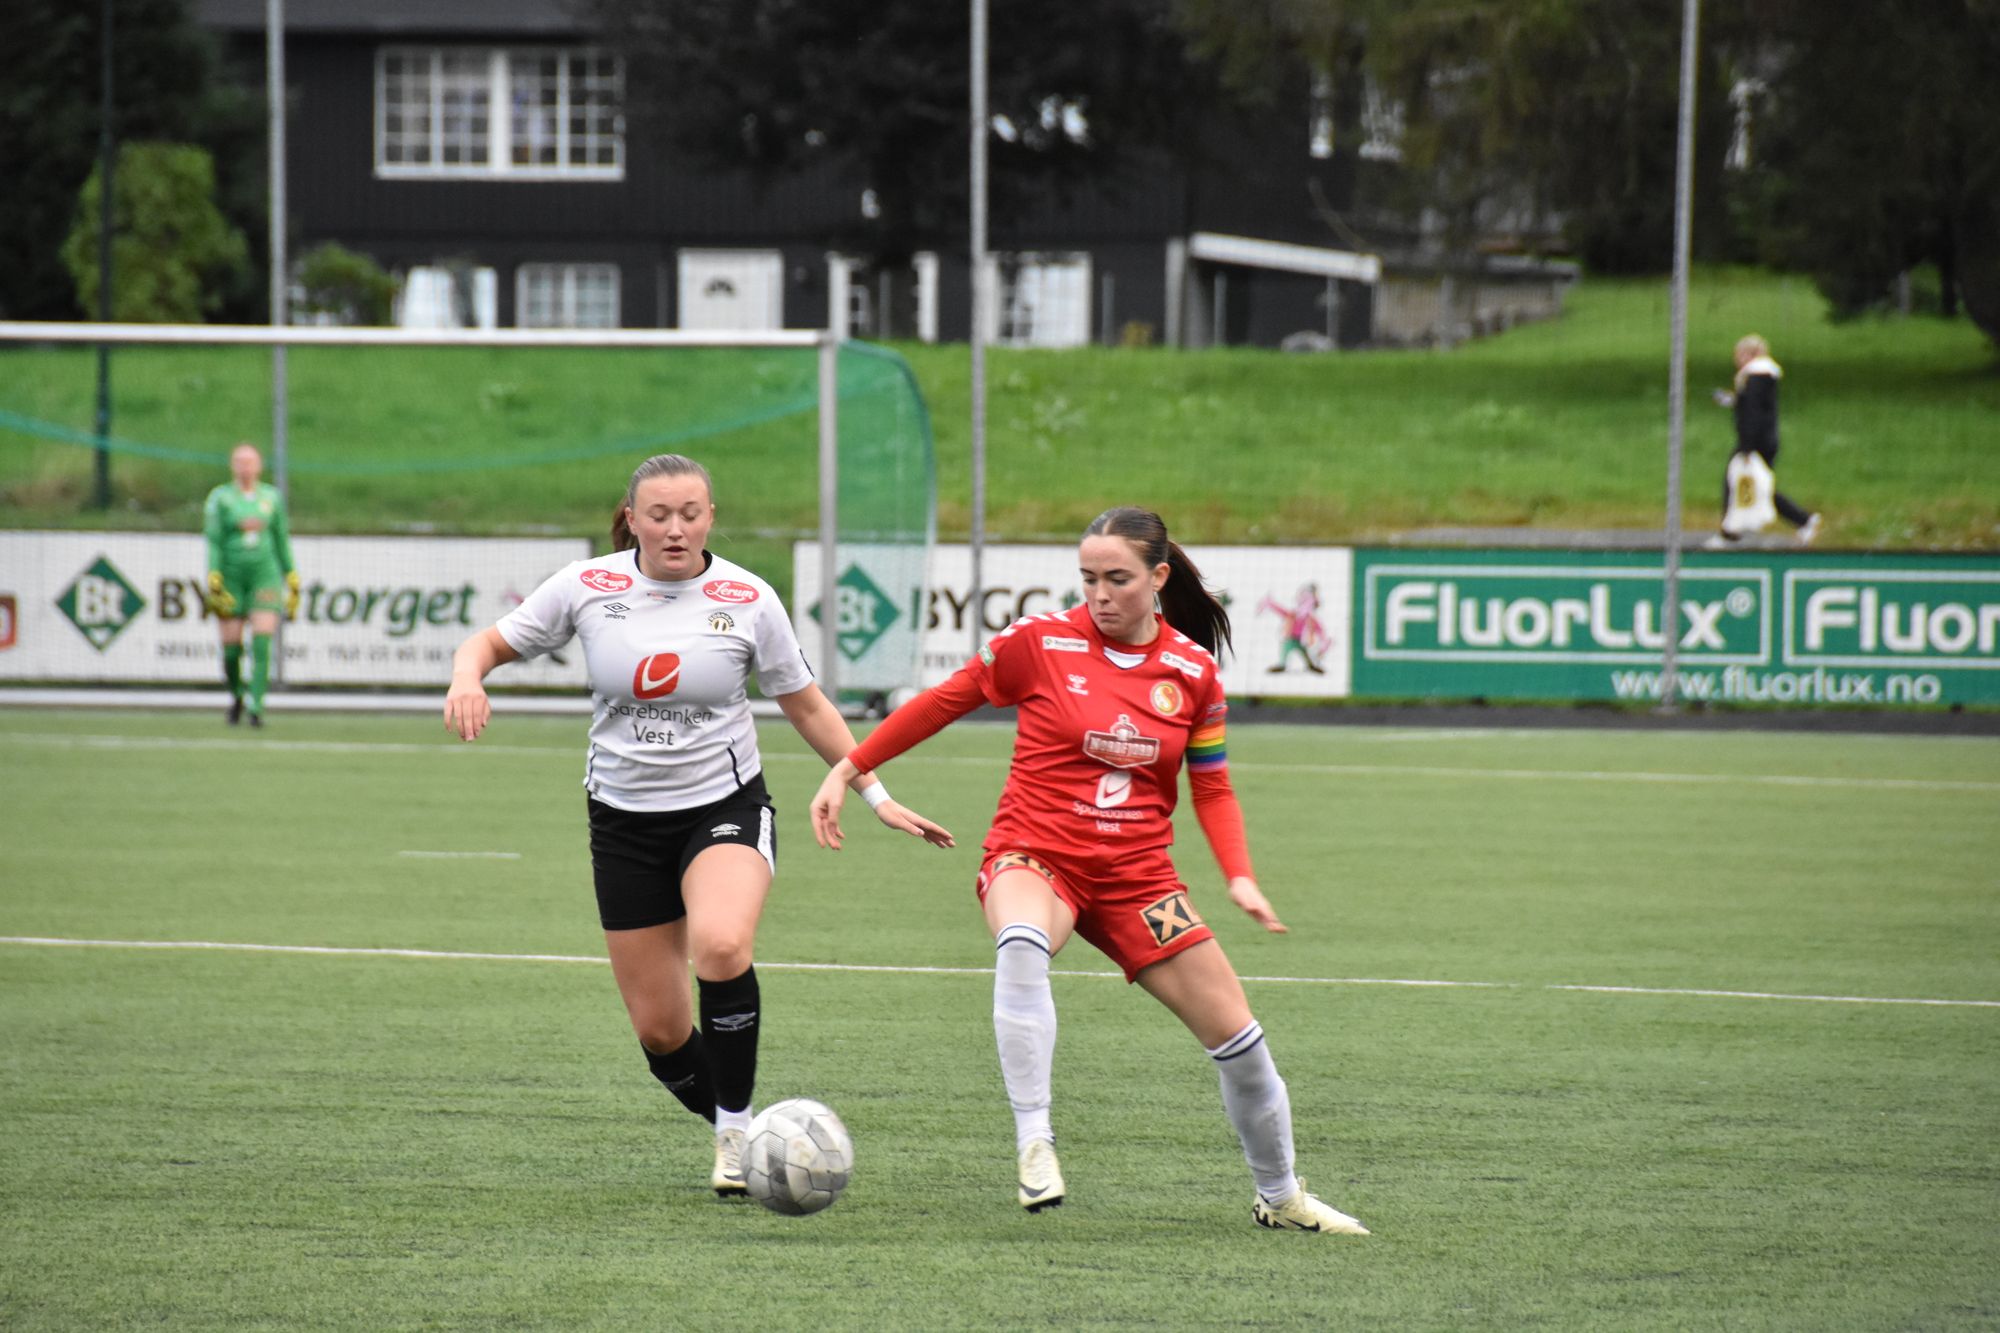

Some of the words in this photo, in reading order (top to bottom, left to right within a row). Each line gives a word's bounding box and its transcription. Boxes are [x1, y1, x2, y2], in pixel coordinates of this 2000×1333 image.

[582, 568, 629, 591] Lerum
[705, 581, 754, 602] Lerum
[633, 723, 675, 746] Vest
[1096, 819, 1121, 833] Vest
